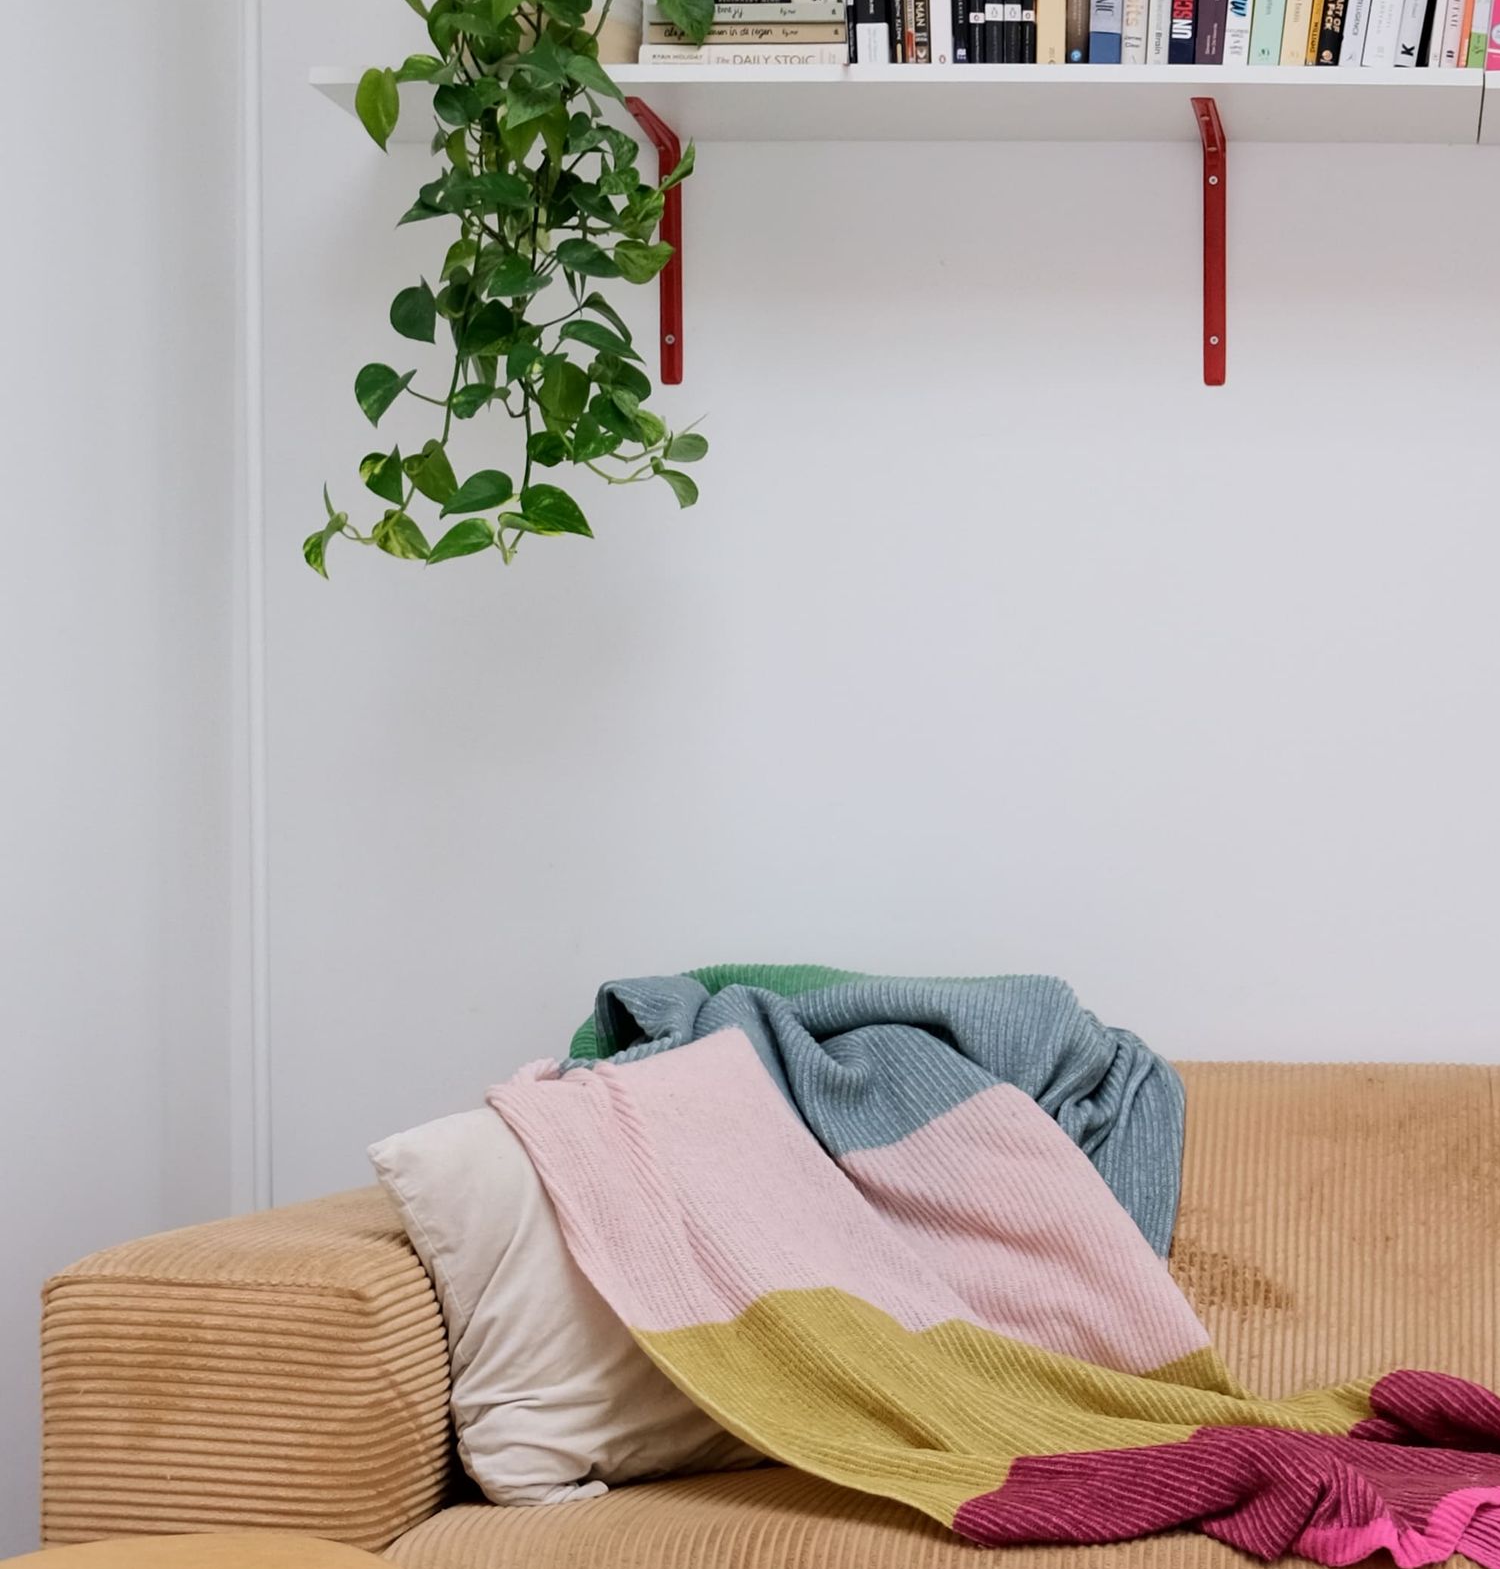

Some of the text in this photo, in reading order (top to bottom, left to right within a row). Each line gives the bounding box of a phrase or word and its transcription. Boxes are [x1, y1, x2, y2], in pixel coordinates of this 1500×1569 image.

[915, 1, 926, 27] MAN
[1332, 18, 1343, 34] OF
[1155, 31, 1163, 55] Brain
[732, 54, 770, 64] DAILY
[774, 54, 817, 64] STOIC
